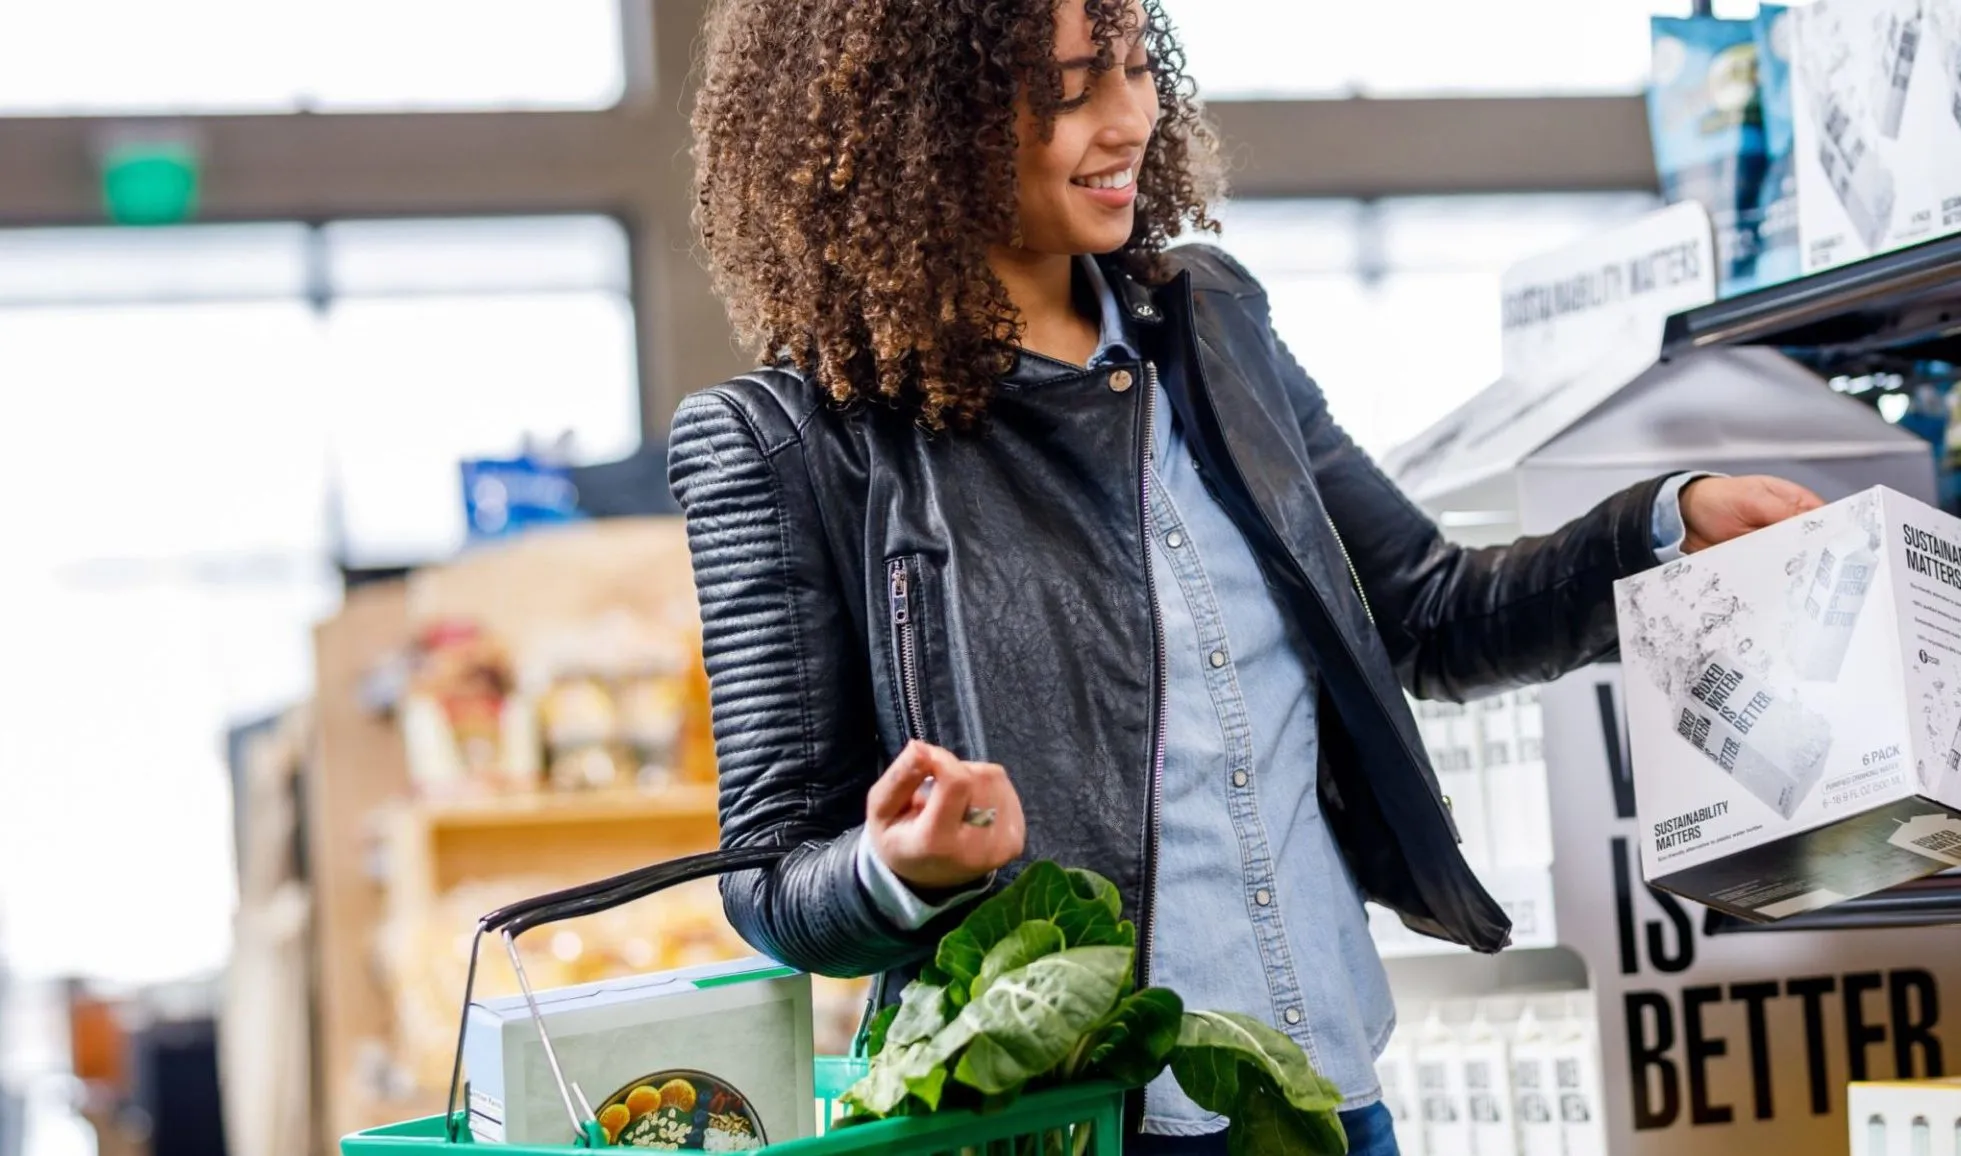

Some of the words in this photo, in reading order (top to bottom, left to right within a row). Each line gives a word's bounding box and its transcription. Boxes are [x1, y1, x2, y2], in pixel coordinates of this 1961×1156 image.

[1905, 548, 1961, 590] MATTERS
[1691, 662, 1726, 702] BOXED
[1704, 672, 1739, 712] WATER
[1718, 705, 1738, 724] IS
[1862, 753, 1870, 766] 6
[1871, 744, 1900, 763] PACK
[1654, 800, 1728, 837] SUSTAINABILITY
[1656, 825, 1701, 852] MATTERS
[1611, 836, 1695, 976] IS
[1623, 967, 1943, 1131] BETTER
